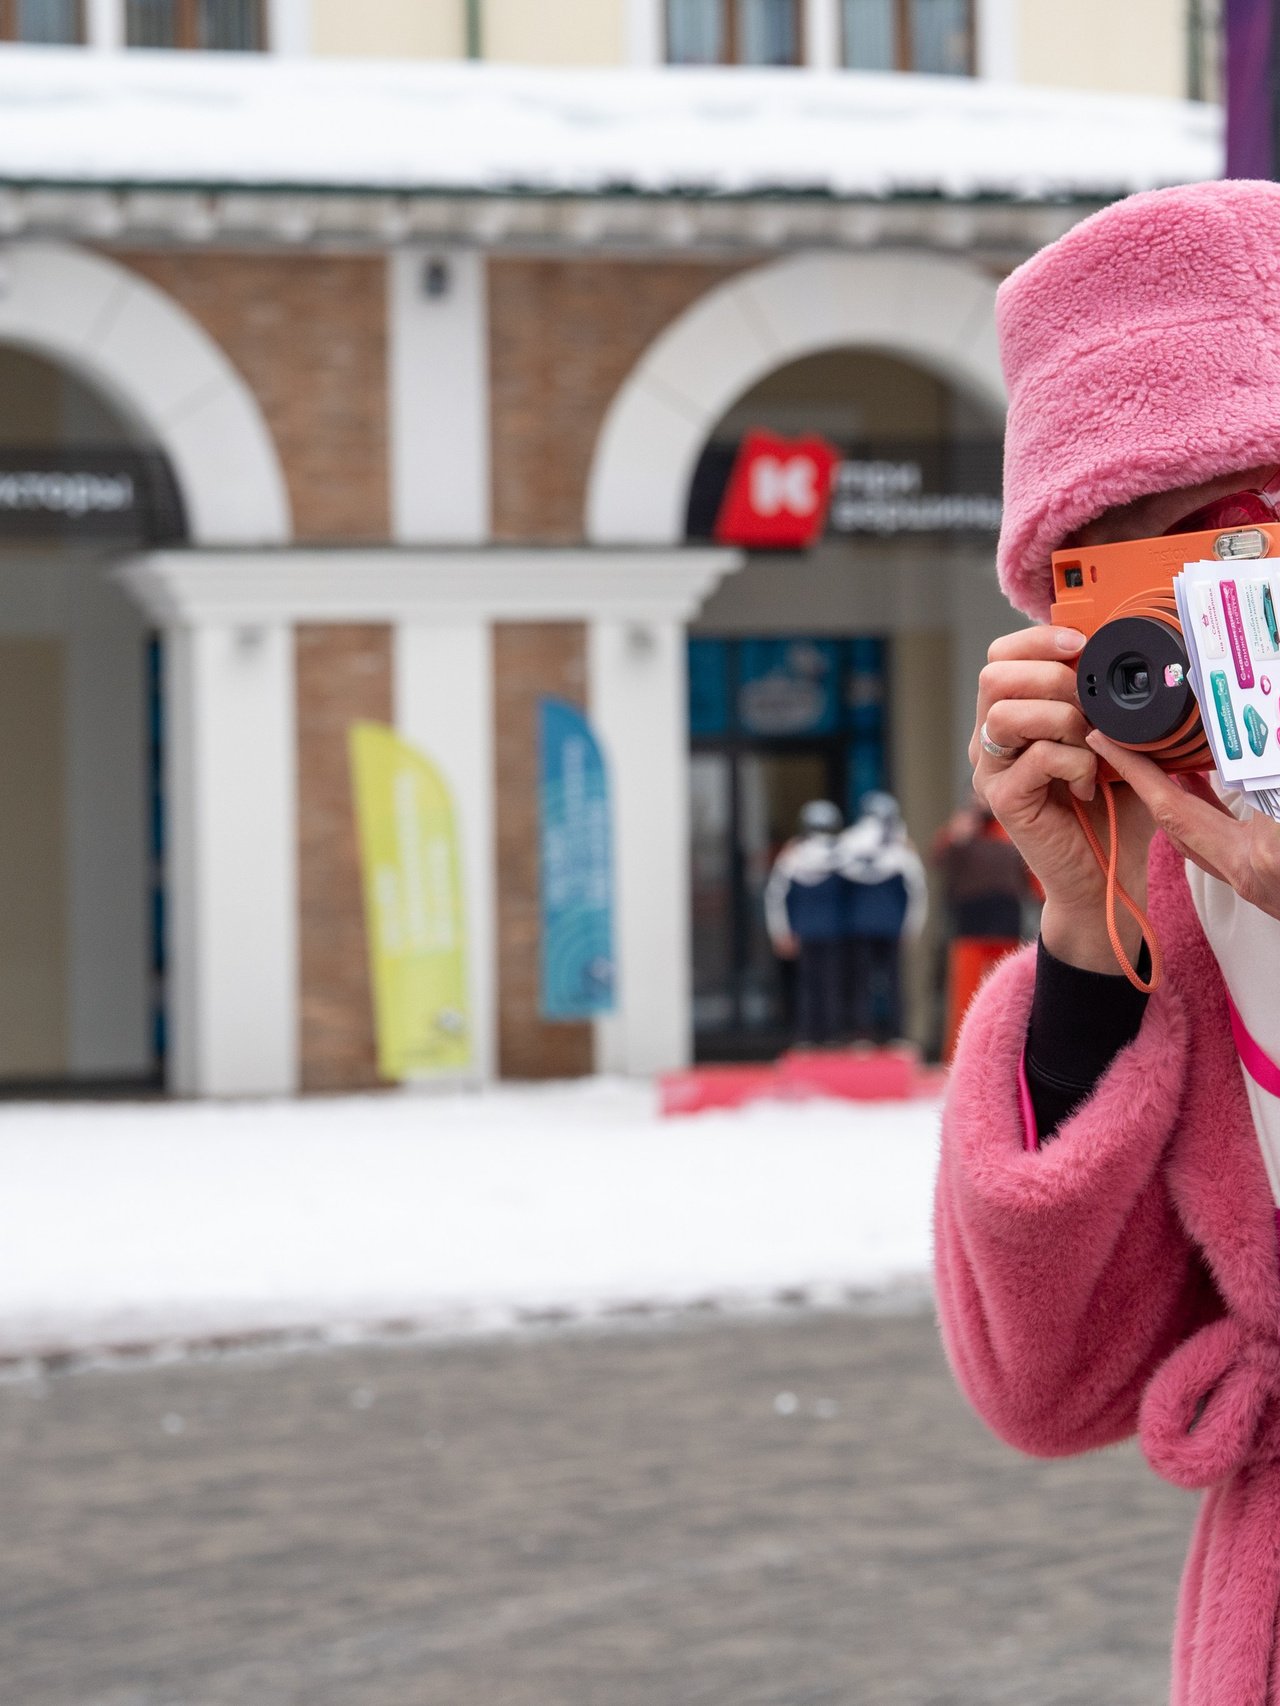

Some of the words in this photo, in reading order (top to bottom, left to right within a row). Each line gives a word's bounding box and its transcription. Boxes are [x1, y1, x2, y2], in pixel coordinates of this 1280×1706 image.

[0, 472, 133, 516] кторы
[1148, 547, 1188, 564] instax
[1239, 635, 1249, 667] ближе
